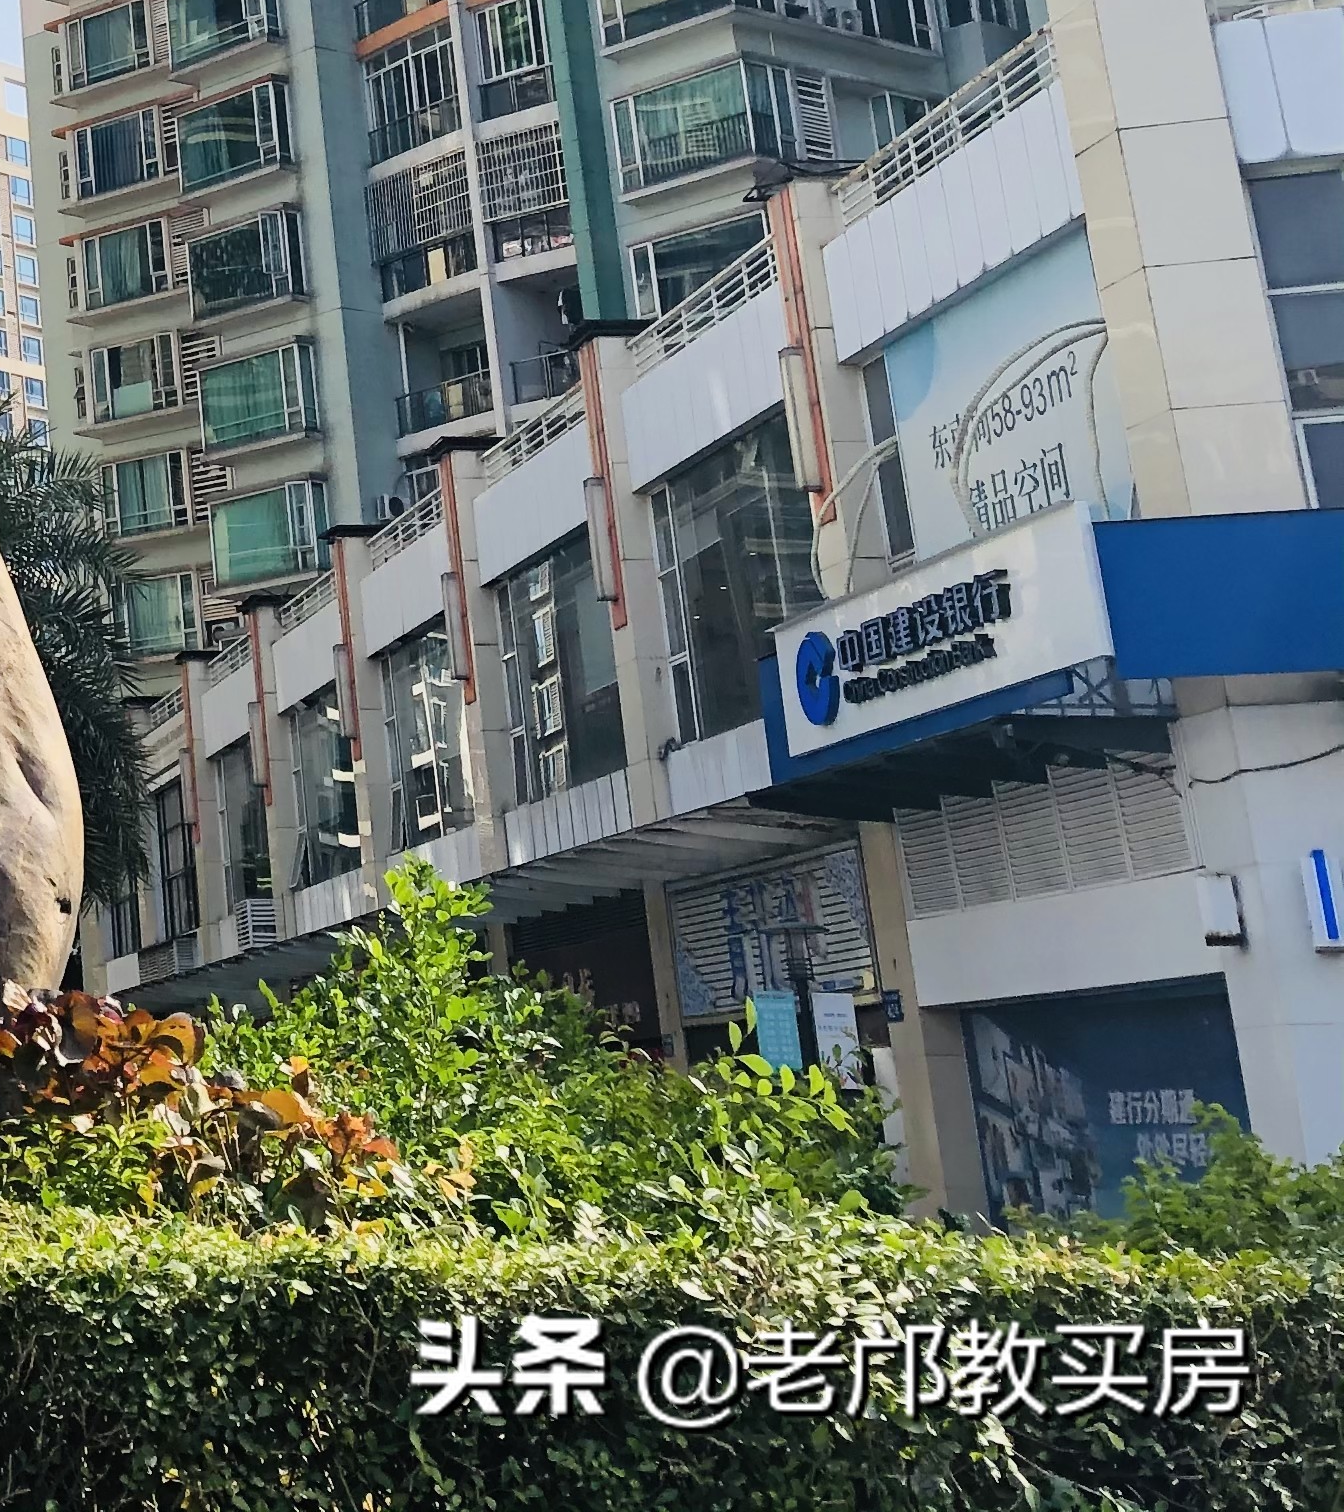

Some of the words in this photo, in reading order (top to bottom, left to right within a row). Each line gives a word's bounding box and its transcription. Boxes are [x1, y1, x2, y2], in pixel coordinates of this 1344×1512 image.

[836, 569, 1011, 672] 中国建设银行
